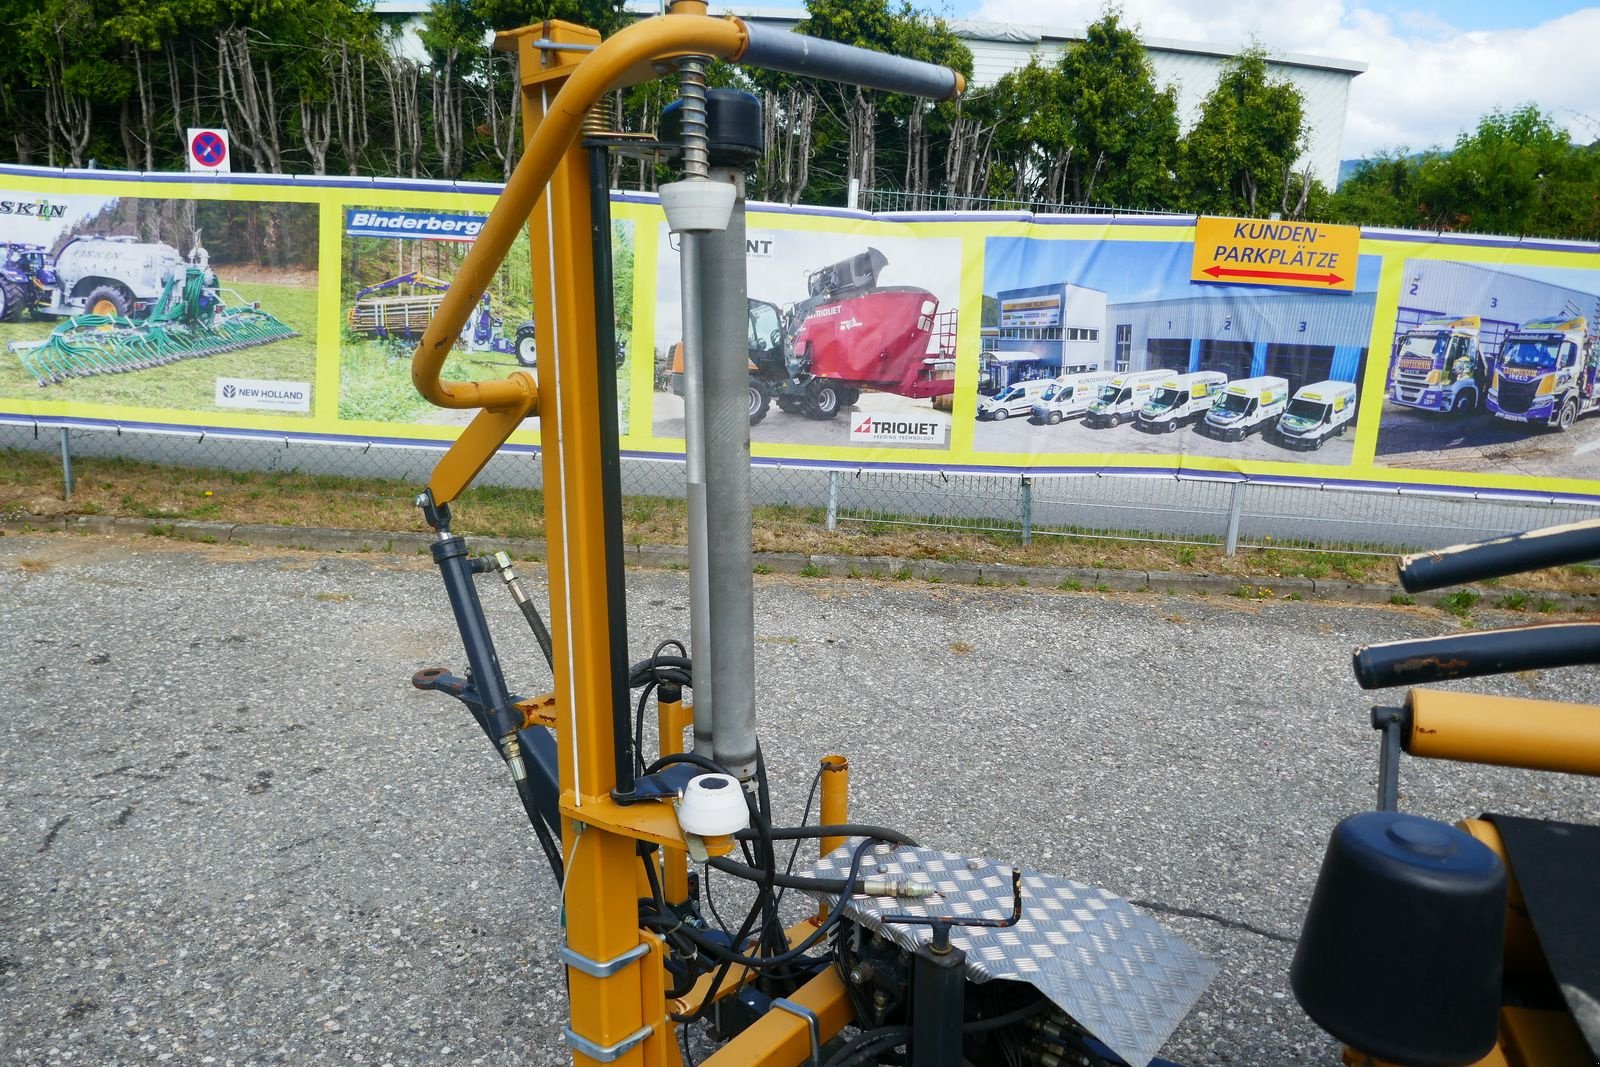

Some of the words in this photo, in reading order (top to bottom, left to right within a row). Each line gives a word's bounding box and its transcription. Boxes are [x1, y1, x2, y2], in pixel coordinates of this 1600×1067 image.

[352, 213, 485, 235] Binderberg
[1234, 223, 1326, 243] KUNDEN-
[1213, 245, 1339, 269] PARKPLÄTZE
[1409, 283, 1419, 296] 2
[1490, 297, 1498, 308] 3
[1224, 320, 1231, 331] 2
[1298, 321, 1307, 332] 3
[239, 388, 259, 397] NEW
[261, 390, 303, 400] HOLLAND
[872, 421, 938, 435] TRIOLIET
